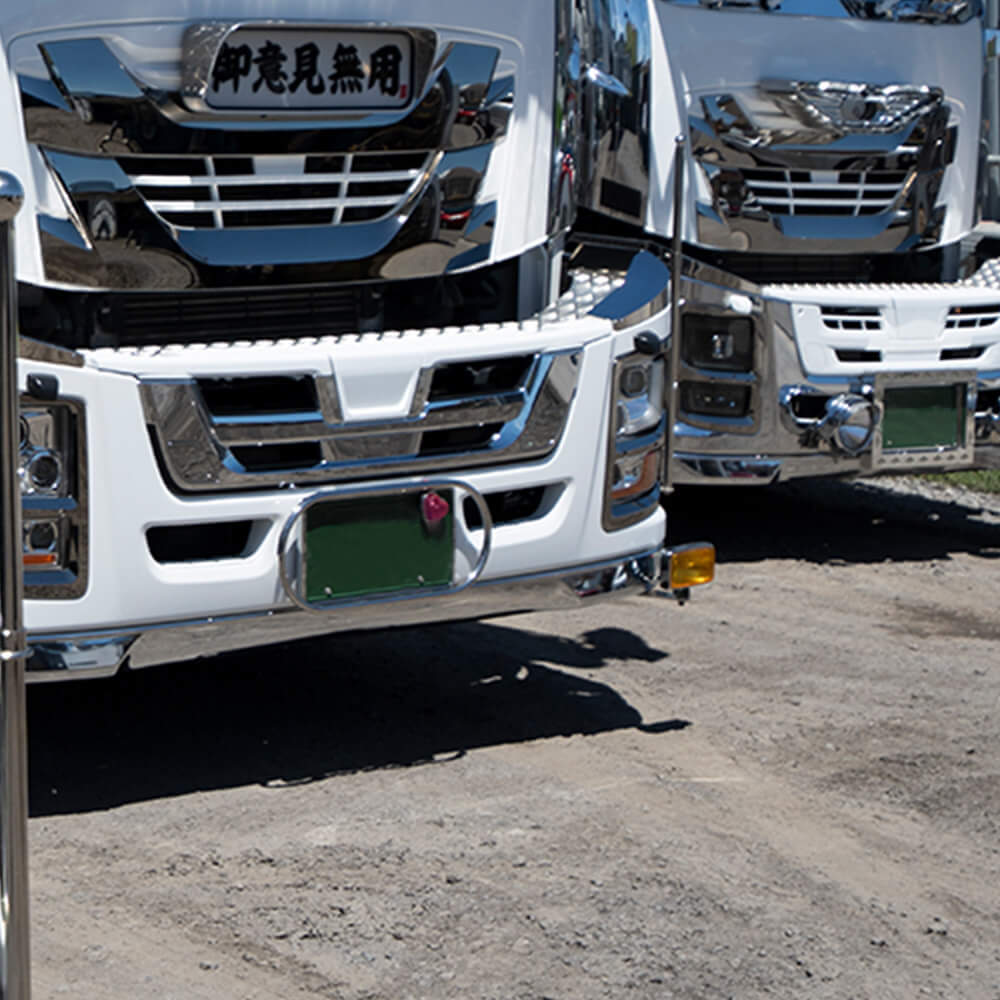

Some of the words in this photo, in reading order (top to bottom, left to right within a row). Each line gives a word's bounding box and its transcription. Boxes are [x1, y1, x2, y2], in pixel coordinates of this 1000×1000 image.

[211, 40, 402, 97] 御意見無用
